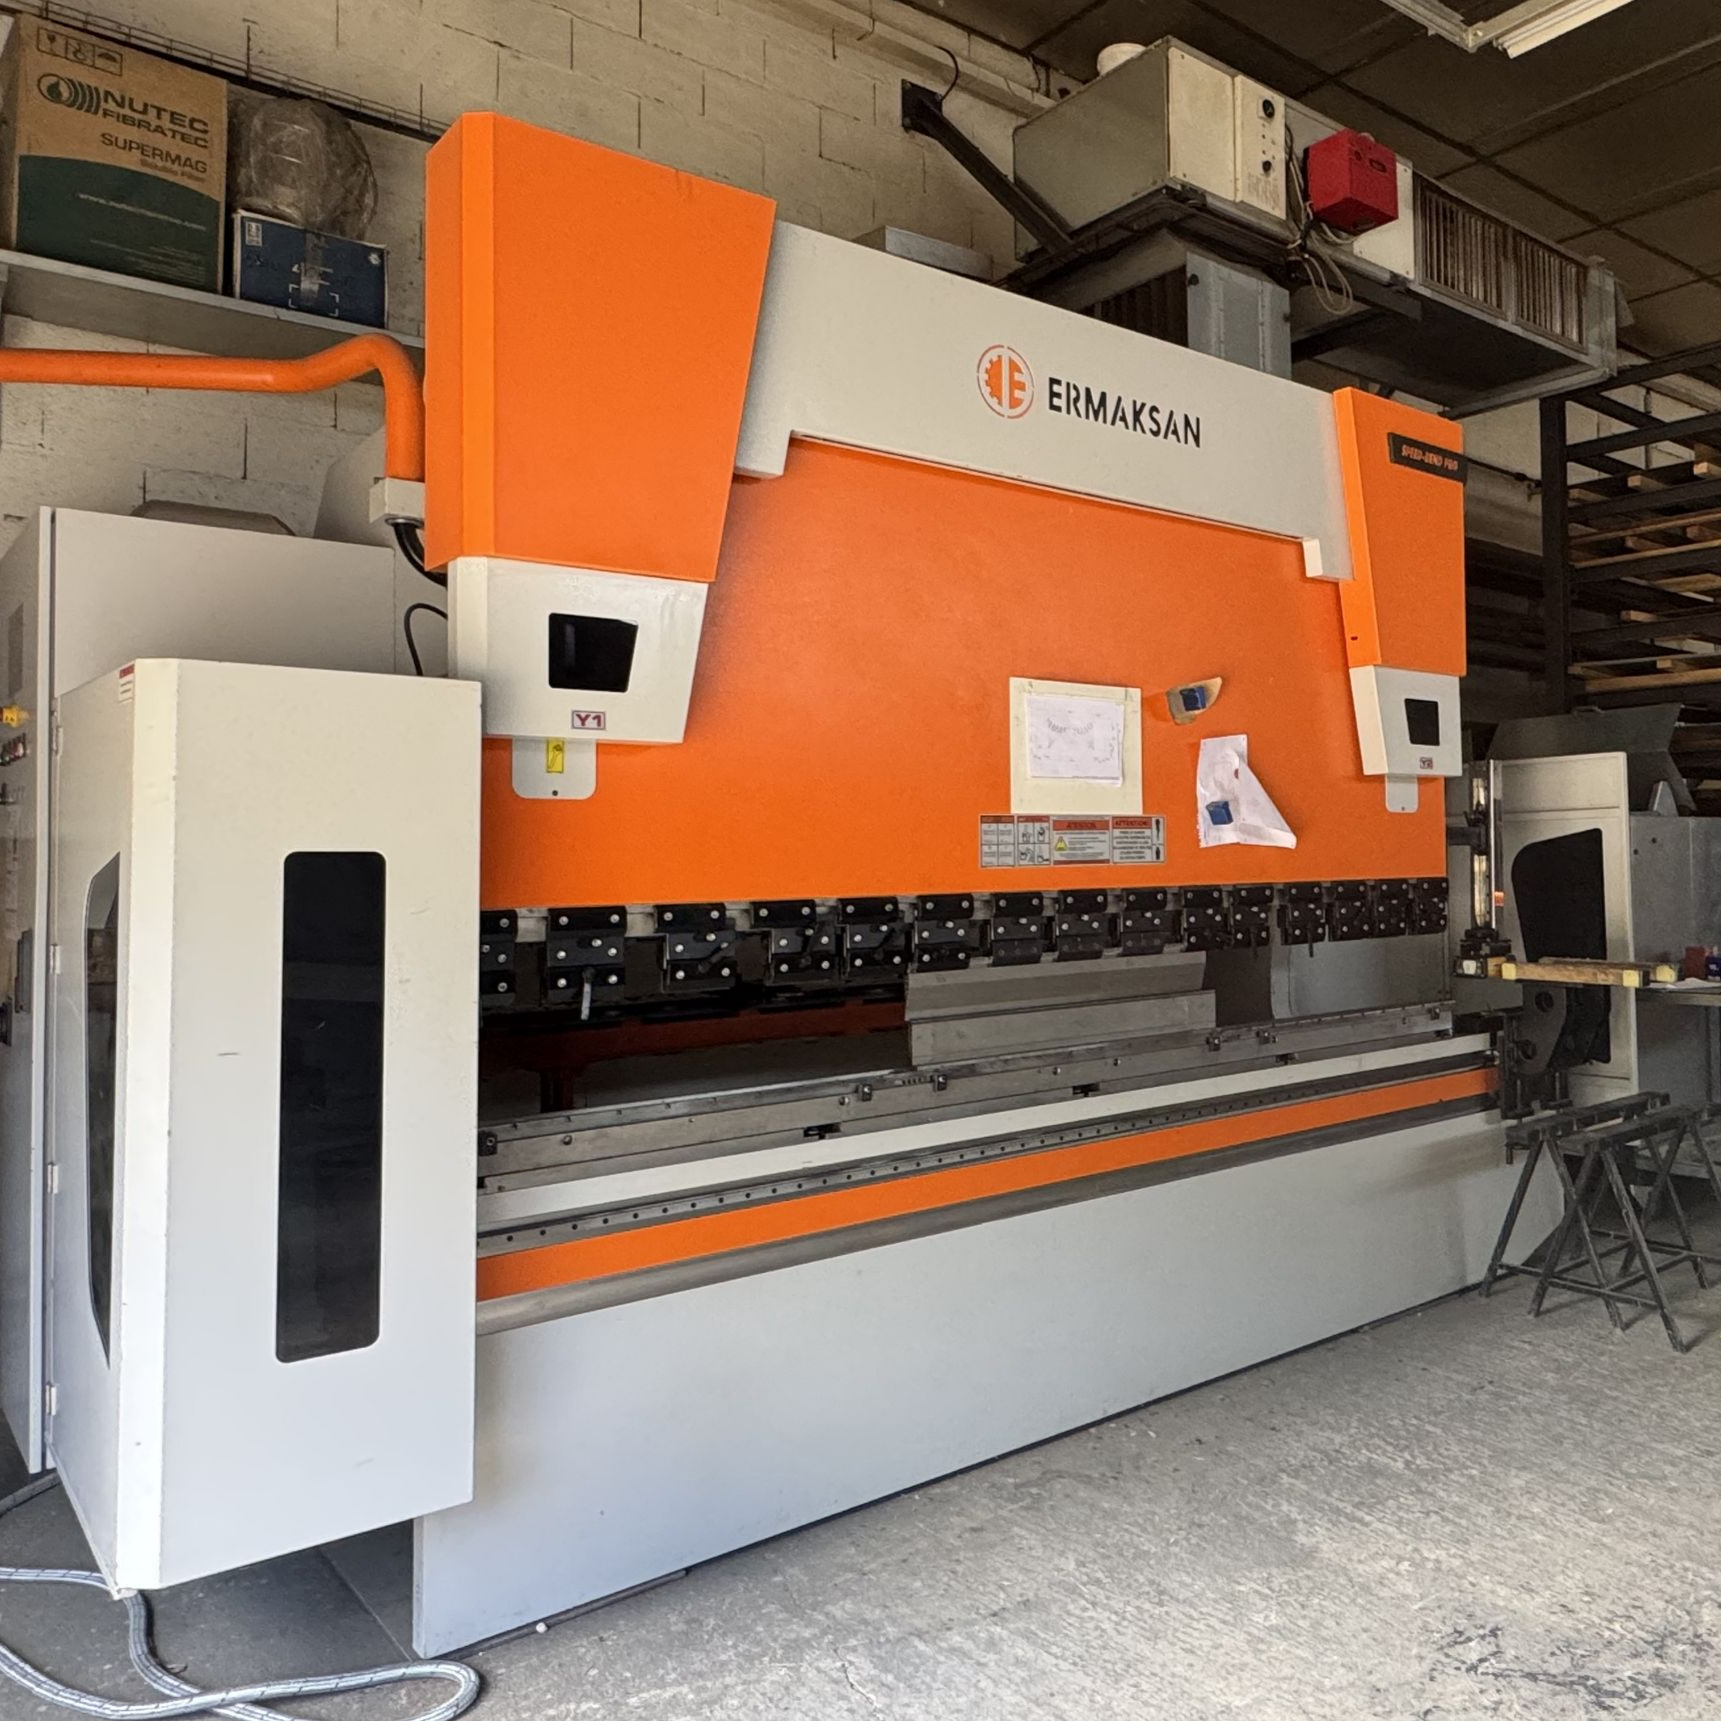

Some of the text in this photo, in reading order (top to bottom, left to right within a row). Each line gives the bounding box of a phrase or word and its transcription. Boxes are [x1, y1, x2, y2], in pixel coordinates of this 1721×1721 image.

[102, 108, 208, 149] FIBRATEC
[103, 90, 209, 135] NUTEC
[101, 133, 207, 173] SUPERMAG
[1048, 376, 1200, 449] ERMAKSAN
[575, 713, 603, 728] Y1
